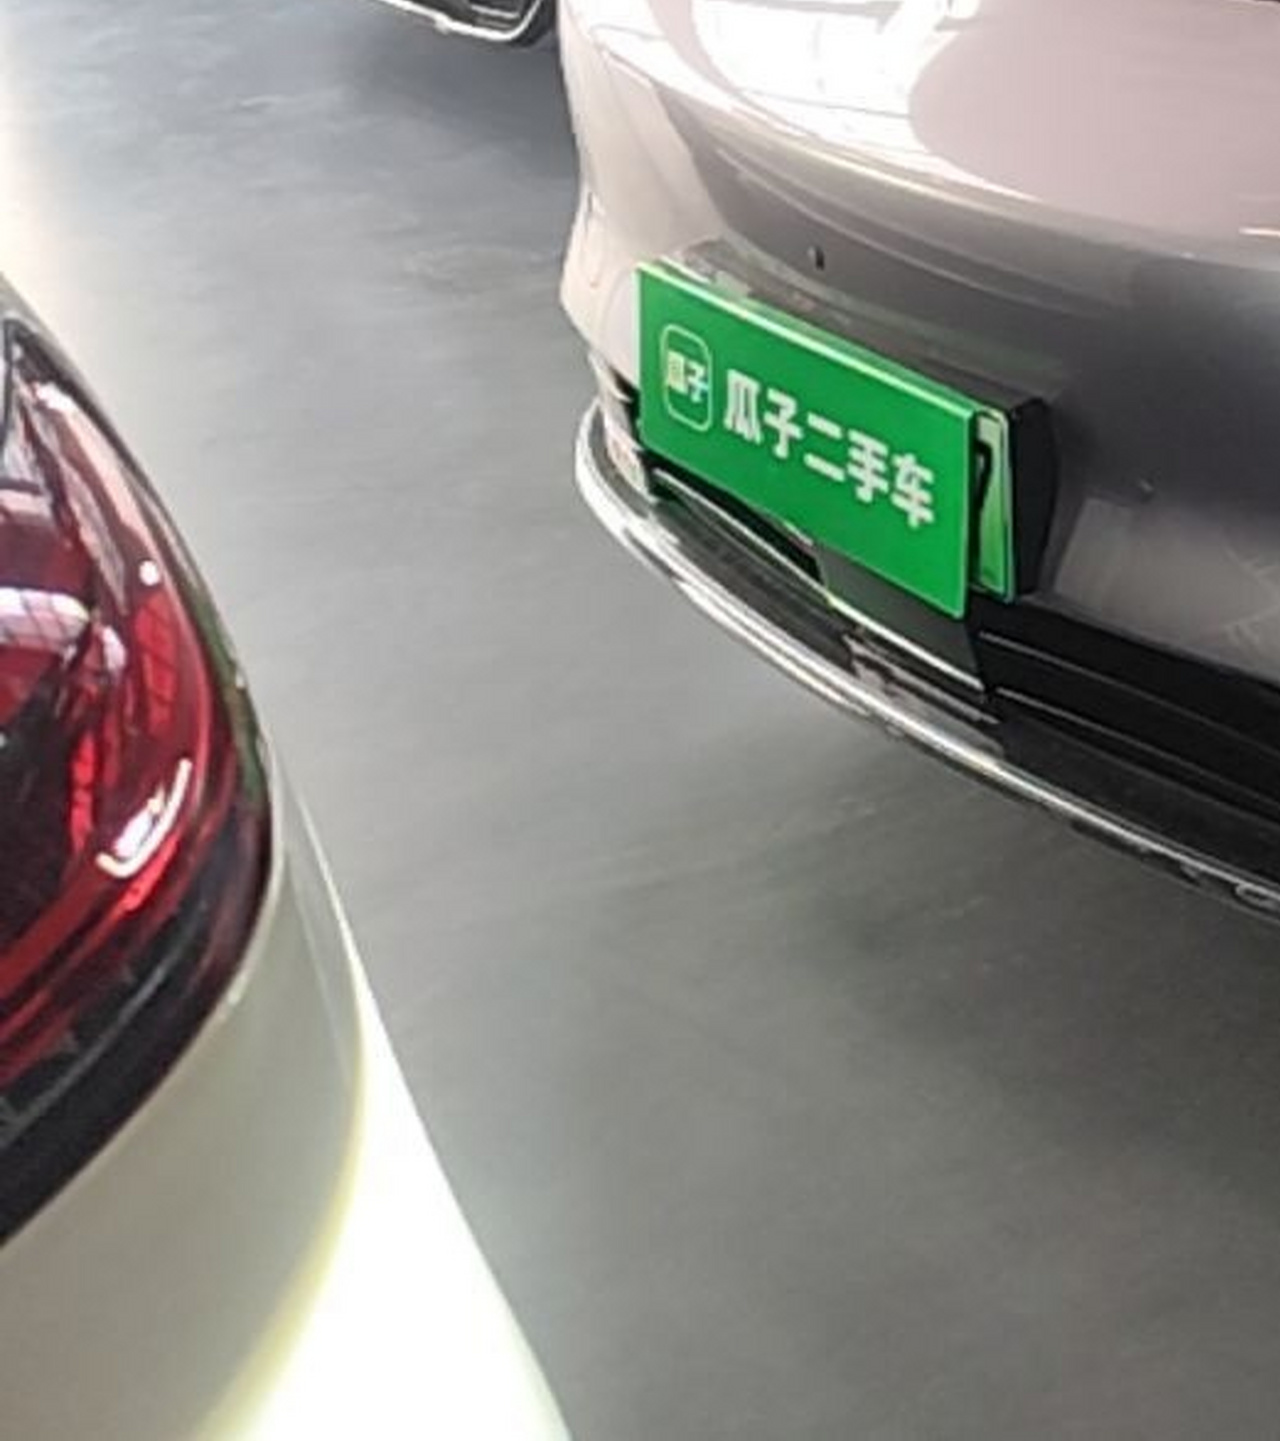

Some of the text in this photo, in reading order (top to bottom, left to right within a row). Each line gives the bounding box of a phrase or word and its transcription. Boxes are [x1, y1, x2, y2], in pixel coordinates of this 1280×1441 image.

[724, 369, 934, 528] 瓜子二手车
